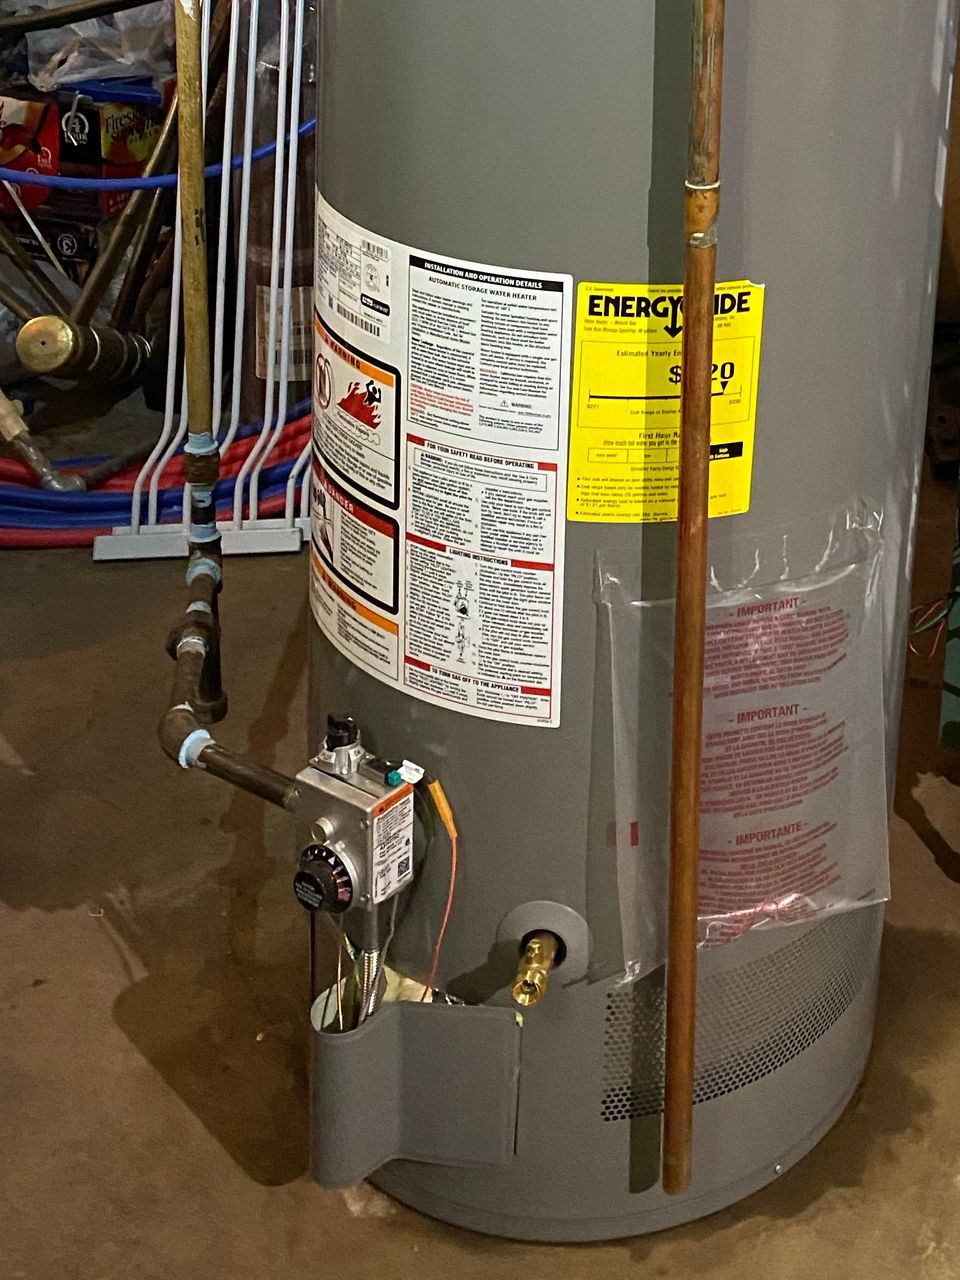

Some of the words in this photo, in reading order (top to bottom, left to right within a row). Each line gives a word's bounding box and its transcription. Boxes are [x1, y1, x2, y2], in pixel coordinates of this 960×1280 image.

[424, 262, 464, 277] INSTALLATION
[479, 274, 514, 285] OPERATION
[516, 280, 542, 288] DETAILS
[429, 276, 460, 289] AUTOMATIC
[461, 284, 488, 294] STORAGE
[489, 289, 511, 297] WATER
[588, 291, 751, 318] ENERGYIDE
[330, 340, 360, 369] WARNING
[668, 362, 735, 385] $20
[427, 442, 436, 450] FOR
[437, 445, 449, 454] YOUR
[450, 448, 468, 458] SAFETY
[469, 452, 483, 461] READ
[484, 456, 503, 465] BEFORE
[505, 460, 534, 469] OPERATING
[450, 548, 471, 559] LIGHTING
[472, 554, 508, 566] INSTRUCTIONS
[737, 597, 799, 617] IMPORTANT
[480, 680, 490, 688] THE
[491, 682, 519, 692] APPLIANCE
[737, 704, 799, 724] IMPORTANT
[736, 821, 801, 846] IMPORTANTE
